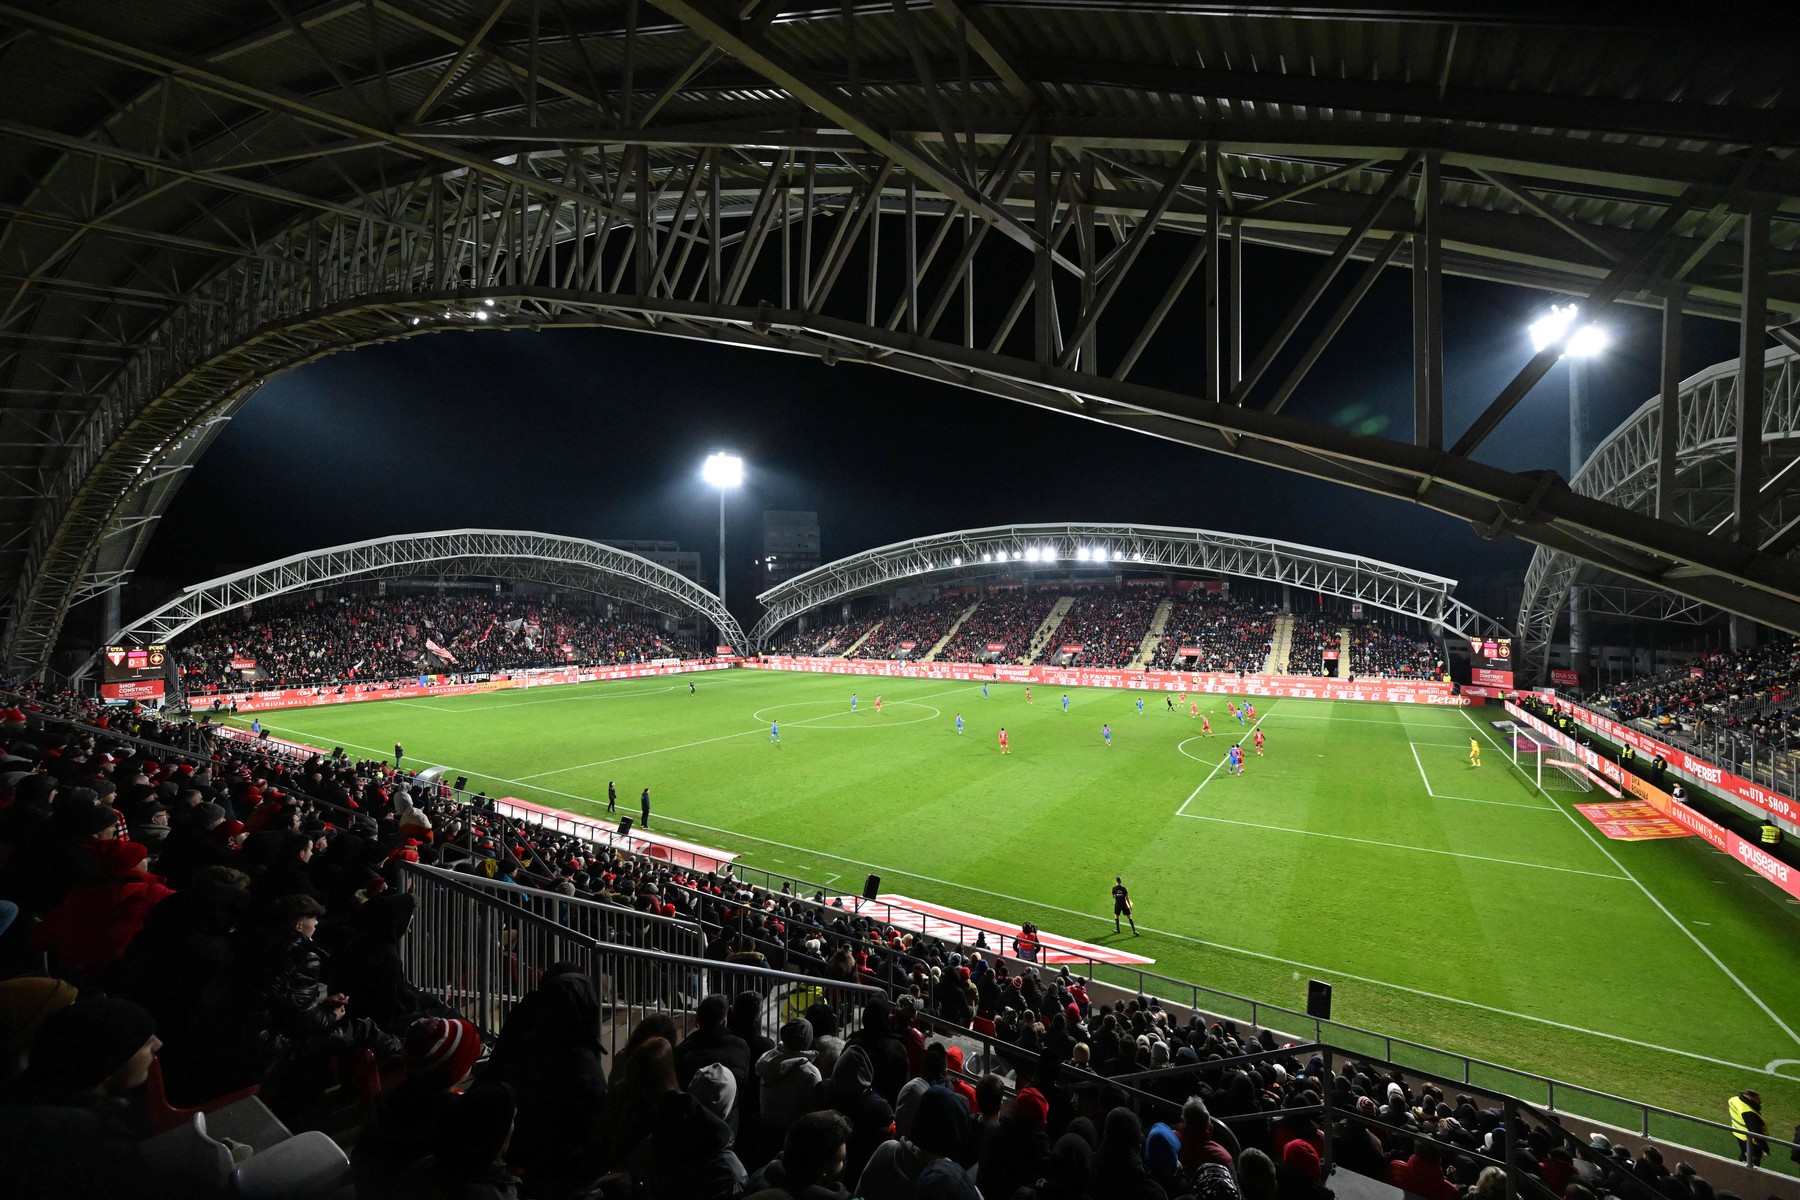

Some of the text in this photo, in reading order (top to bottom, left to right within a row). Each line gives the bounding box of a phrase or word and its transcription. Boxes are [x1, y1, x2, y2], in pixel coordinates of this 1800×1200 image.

[1568, 672, 1577, 680] SOL
[119, 686, 153, 694] CONSTRUCT
[1427, 695, 1471, 705] Betano
[1684, 755, 1722, 784] SUPERBET
[1738, 841, 1788, 882] apuseana
